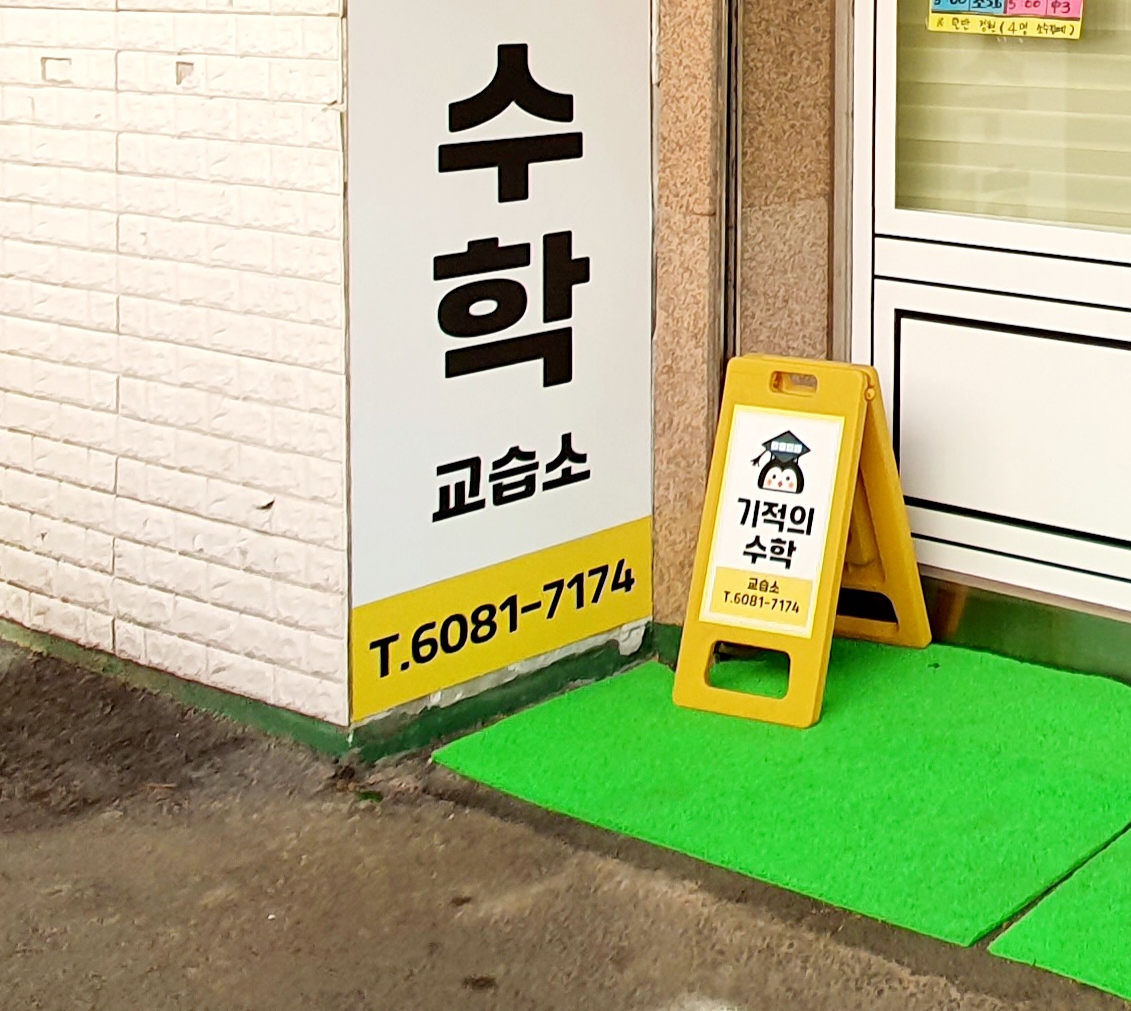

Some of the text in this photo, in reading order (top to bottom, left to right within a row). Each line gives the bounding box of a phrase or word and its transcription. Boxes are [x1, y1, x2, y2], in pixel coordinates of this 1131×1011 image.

[433, 42, 591, 388] 수학
[431, 432, 591, 523] 교습소
[737, 497, 815, 536] 기적의
[742, 535, 798, 570] 수학
[723, 590, 800, 614] T.6081-7174
[747, 577, 780, 594] 교습소
[369, 556, 637, 679] T.6081-7174
